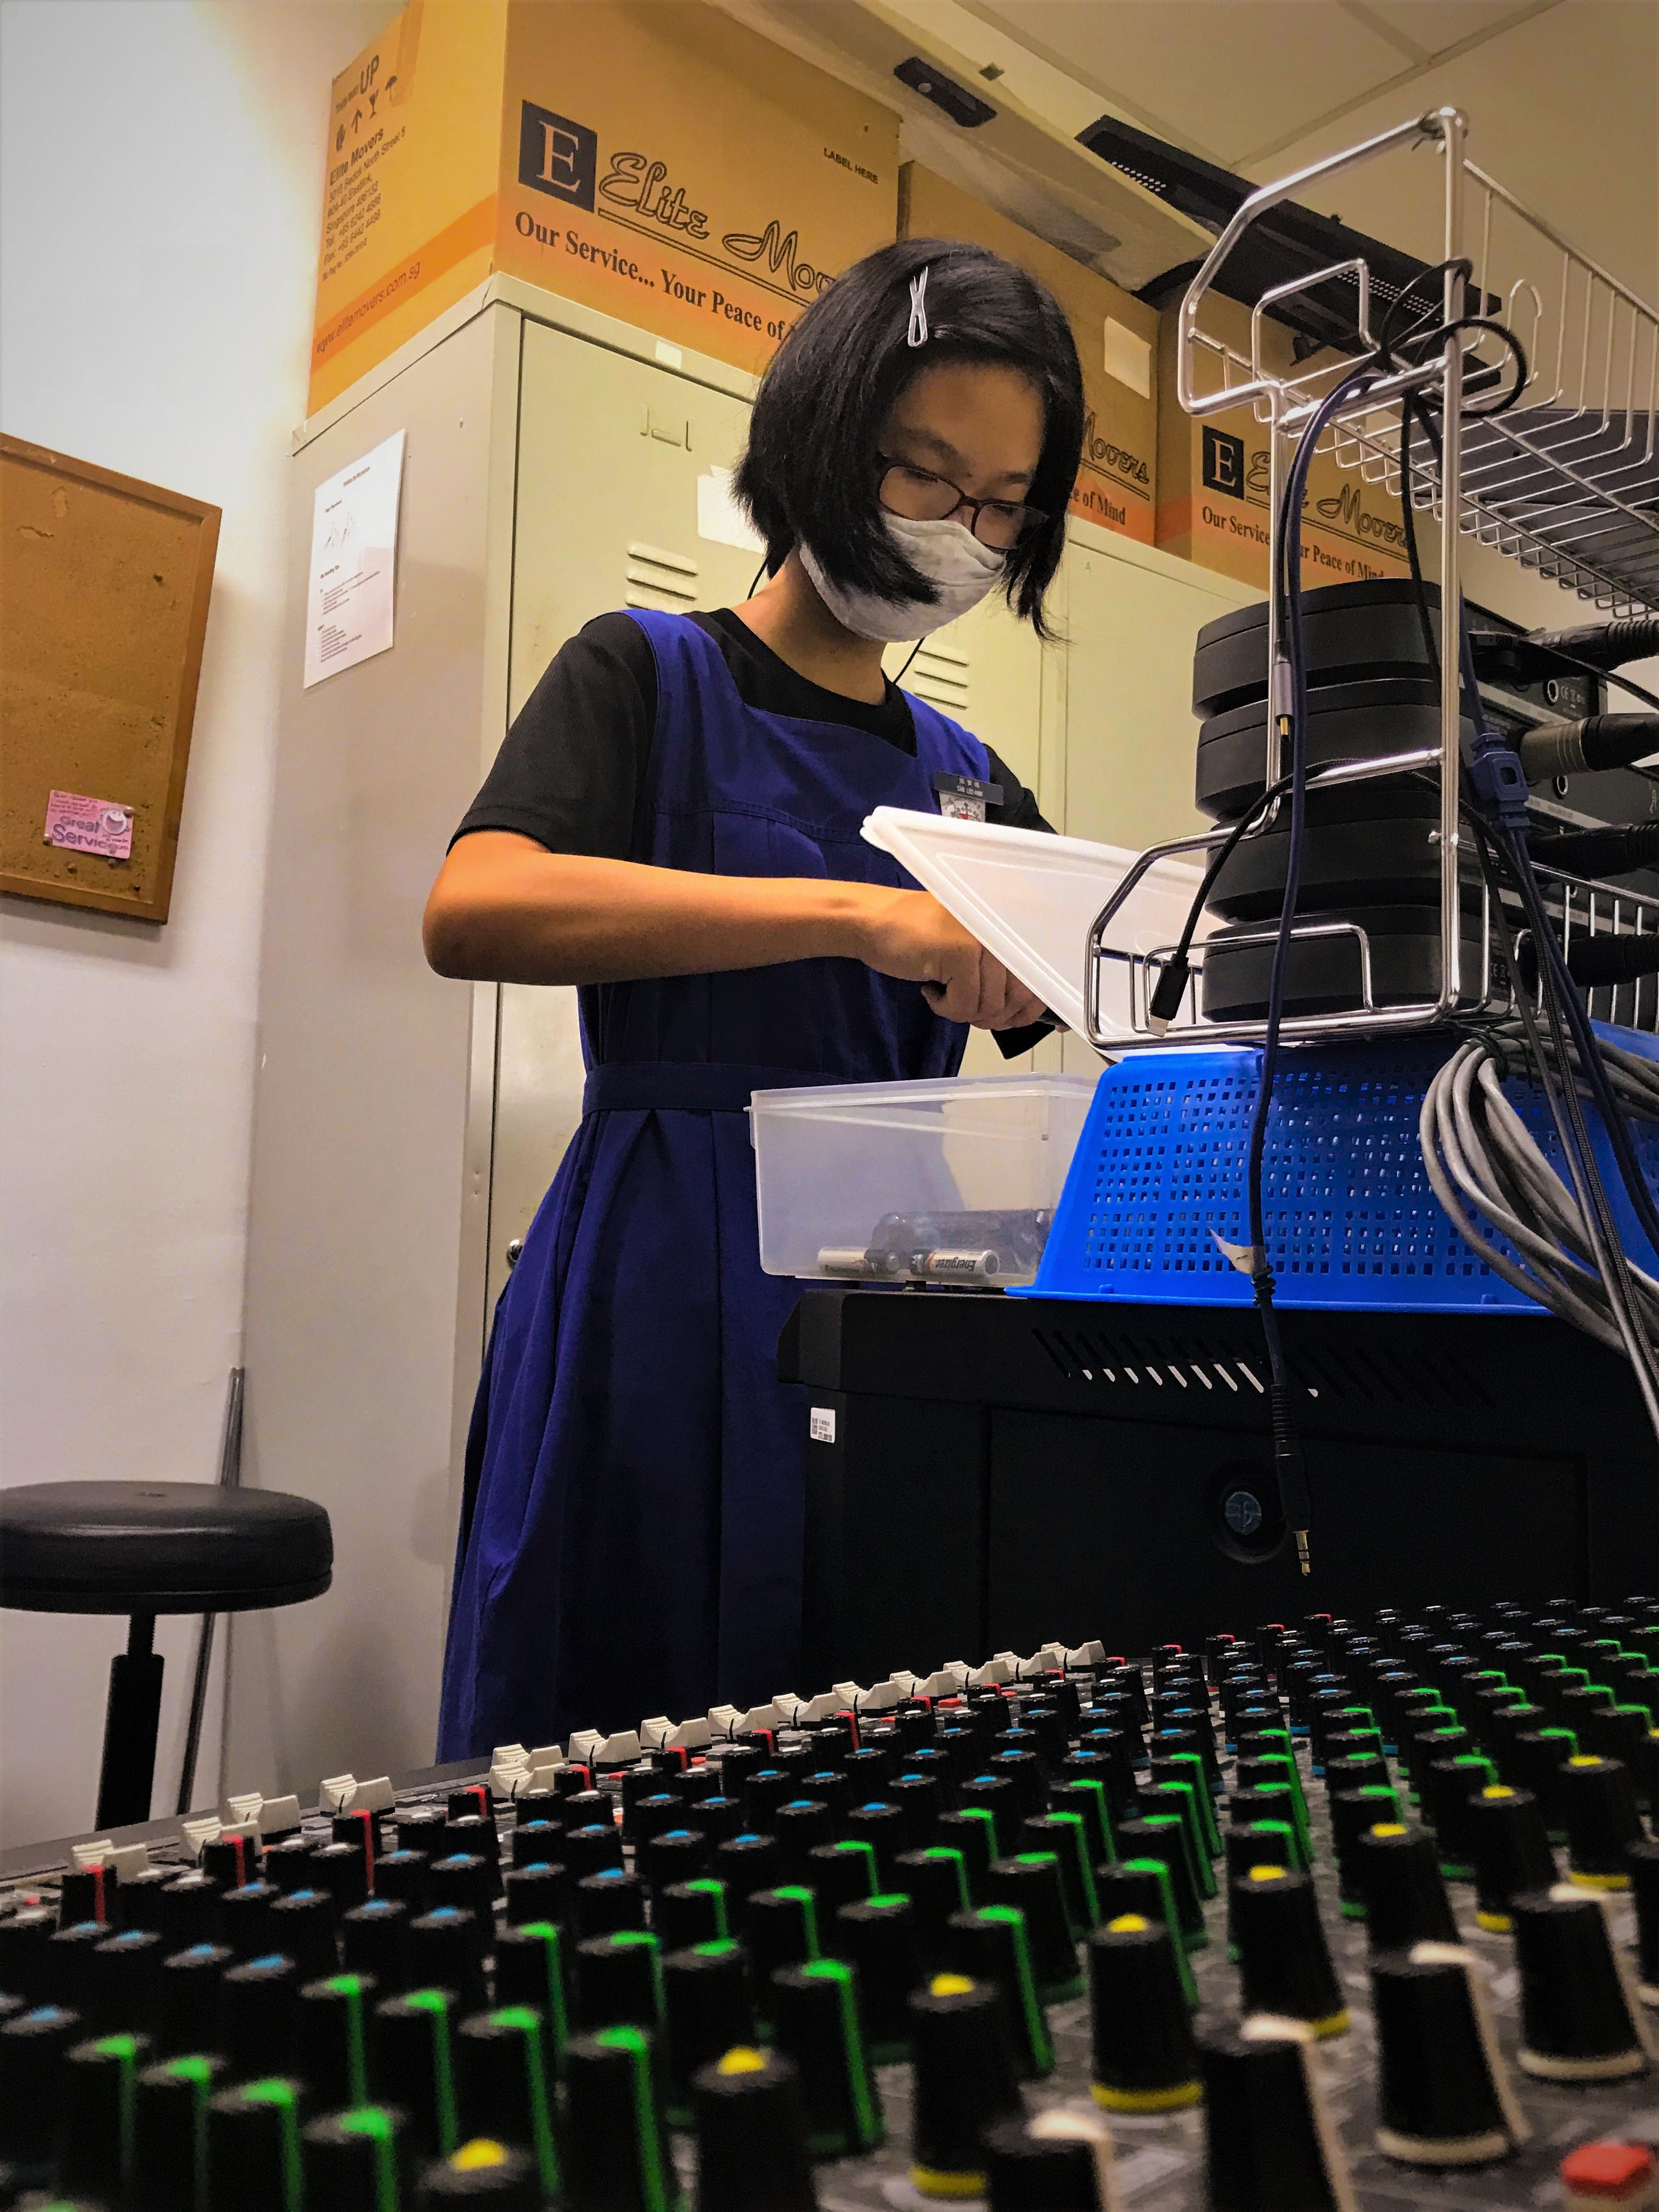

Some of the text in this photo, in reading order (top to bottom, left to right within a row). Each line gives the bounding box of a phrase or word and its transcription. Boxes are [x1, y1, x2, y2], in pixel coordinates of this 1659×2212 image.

[360, 54, 380, 95] UP
[330, 128, 384, 186] Elite Movers
[363, 150, 381, 172] North
[381, 131, 400, 156] Street
[400, 125, 407, 138] 5
[535, 119, 582, 193] E
[823, 147, 879, 185] LABEL HERE
[325, 204, 356, 234] Singapore
[599, 152, 710, 240] Elite
[515, 211, 786, 341] Our Service... Your Peace of
[1211, 437, 1238, 488] E
[1082, 490, 1096, 510] of
[1097, 495, 1126, 526] Mind
[1316, 483, 1413, 549] Mover
[1202, 505, 1227, 530] Our
[1312, 545, 1342, 571] Peace
[1344, 559, 1355, 577] of
[52, 823, 119, 854] Service
[935, 1255, 977, 1272] Energizer
